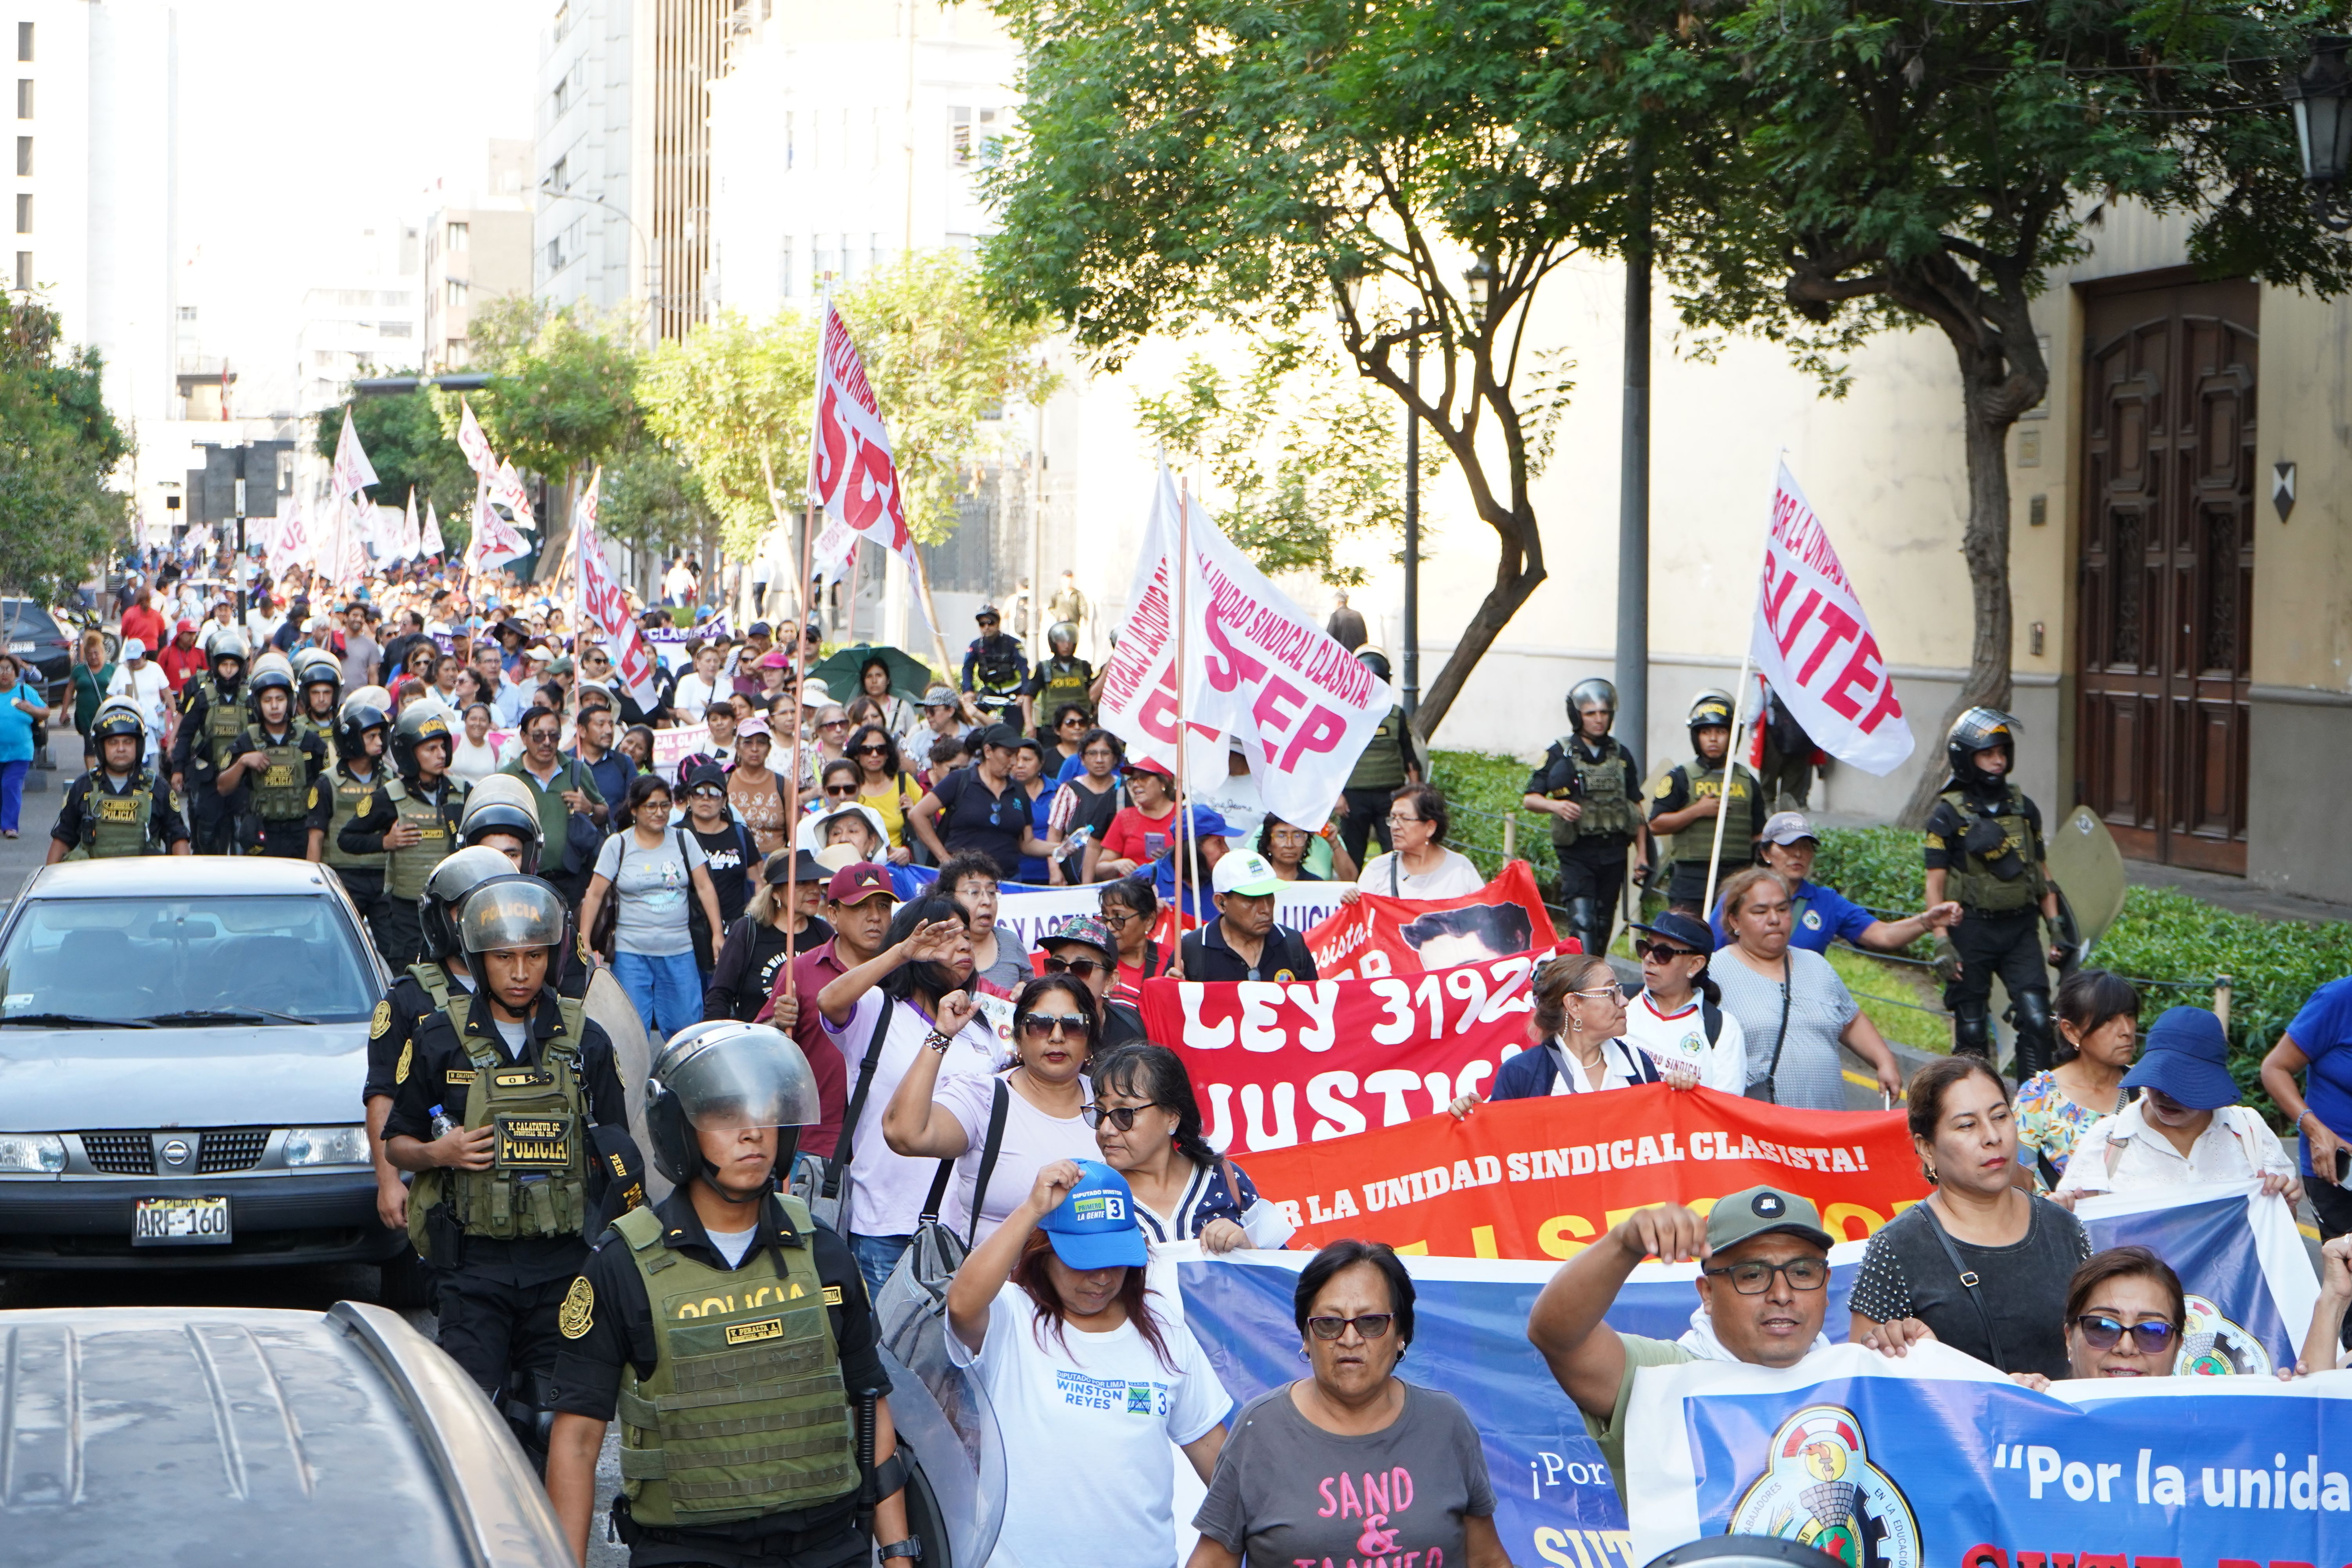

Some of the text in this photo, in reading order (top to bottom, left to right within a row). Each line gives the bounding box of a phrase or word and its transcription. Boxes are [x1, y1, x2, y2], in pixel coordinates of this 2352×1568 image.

[1772, 487, 1797, 543] POR
[1785, 506, 1813, 556] LA
[1245, 607, 1316, 672] SINDICAL
[1305, 639, 1375, 710] CLASISTA!
[102, 713, 135, 728] POLICIA
[215, 726, 238, 735] POLICIA
[419, 718, 448, 737] POLICIA
[264, 776, 294, 786] POLICIA
[103, 809, 134, 822] POLICIA
[854, 869, 880, 886] CAT
[481, 902, 541, 926] POLICIA
[761, 966, 772, 977] DO
[767, 952, 788, 968] WHA
[1178, 980, 1339, 1053] LEY
[1665, 1058, 1702, 1080] SINDICAL
[508, 1122, 561, 1132] M. CALATAYUD CC.
[502, 1136, 567, 1160] POLICIA
[609, 1153, 627, 1177] PERU
[1306, 1189, 1359, 1225] LA
[1362, 1155, 1502, 1212] UNIDAD
[1506, 1131, 1685, 1182] SINDICAL
[1689, 1131, 1870, 1173] CLASISTA!
[165, 1199, 197, 1208] PERU
[1073, 1189, 1102, 1199] DIPUTADO
[1078, 1199, 1121, 1218] PRIMERO 3
[1087, 1210, 1105, 1220] GENTE
[138, 1207, 226, 1236] ARF-160
[739, 1325, 769, 1336] PERALTA
[2215, 1354, 2231, 1371] SINDICAL
[1058, 1371, 1091, 1383] DIPUTADO
[1057, 1378, 1122, 1401] WINSTON
[1065, 1393, 1111, 1410] REYES
[1158, 1392, 1167, 1416] 3
[1530, 1452, 1606, 1500] ¡Por
[2136, 1448, 2186, 1505] la
[1318, 1466, 1414, 1519] SAND
[1356, 1514, 1403, 1557] &
[1874, 1488, 1911, 1568] EN LA EDUCACIÓ
[1851, 1523, 1862, 1558] SINDICAL
